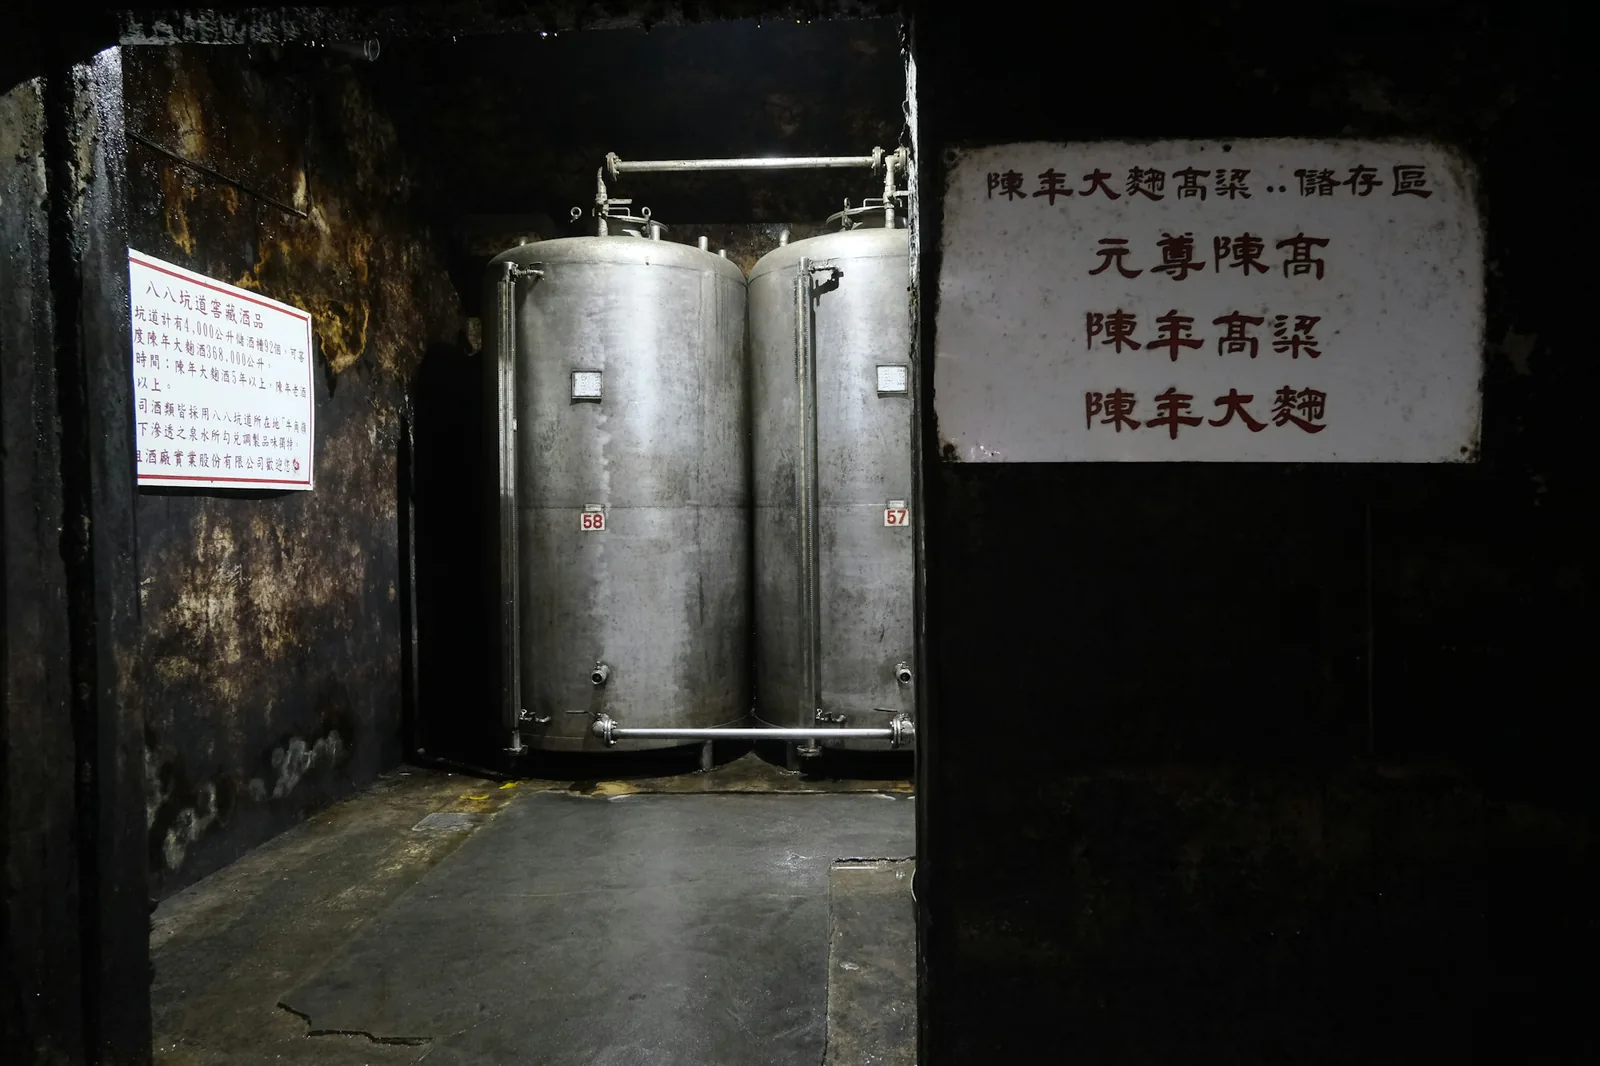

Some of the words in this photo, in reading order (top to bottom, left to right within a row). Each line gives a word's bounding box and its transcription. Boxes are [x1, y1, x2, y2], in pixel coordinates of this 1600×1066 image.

[146, 280, 264, 329] 八八坑道窖藏酒品
[137, 377, 171, 393] 以上。
[583, 514, 603, 529] 58
[887, 510, 907, 525] 57
